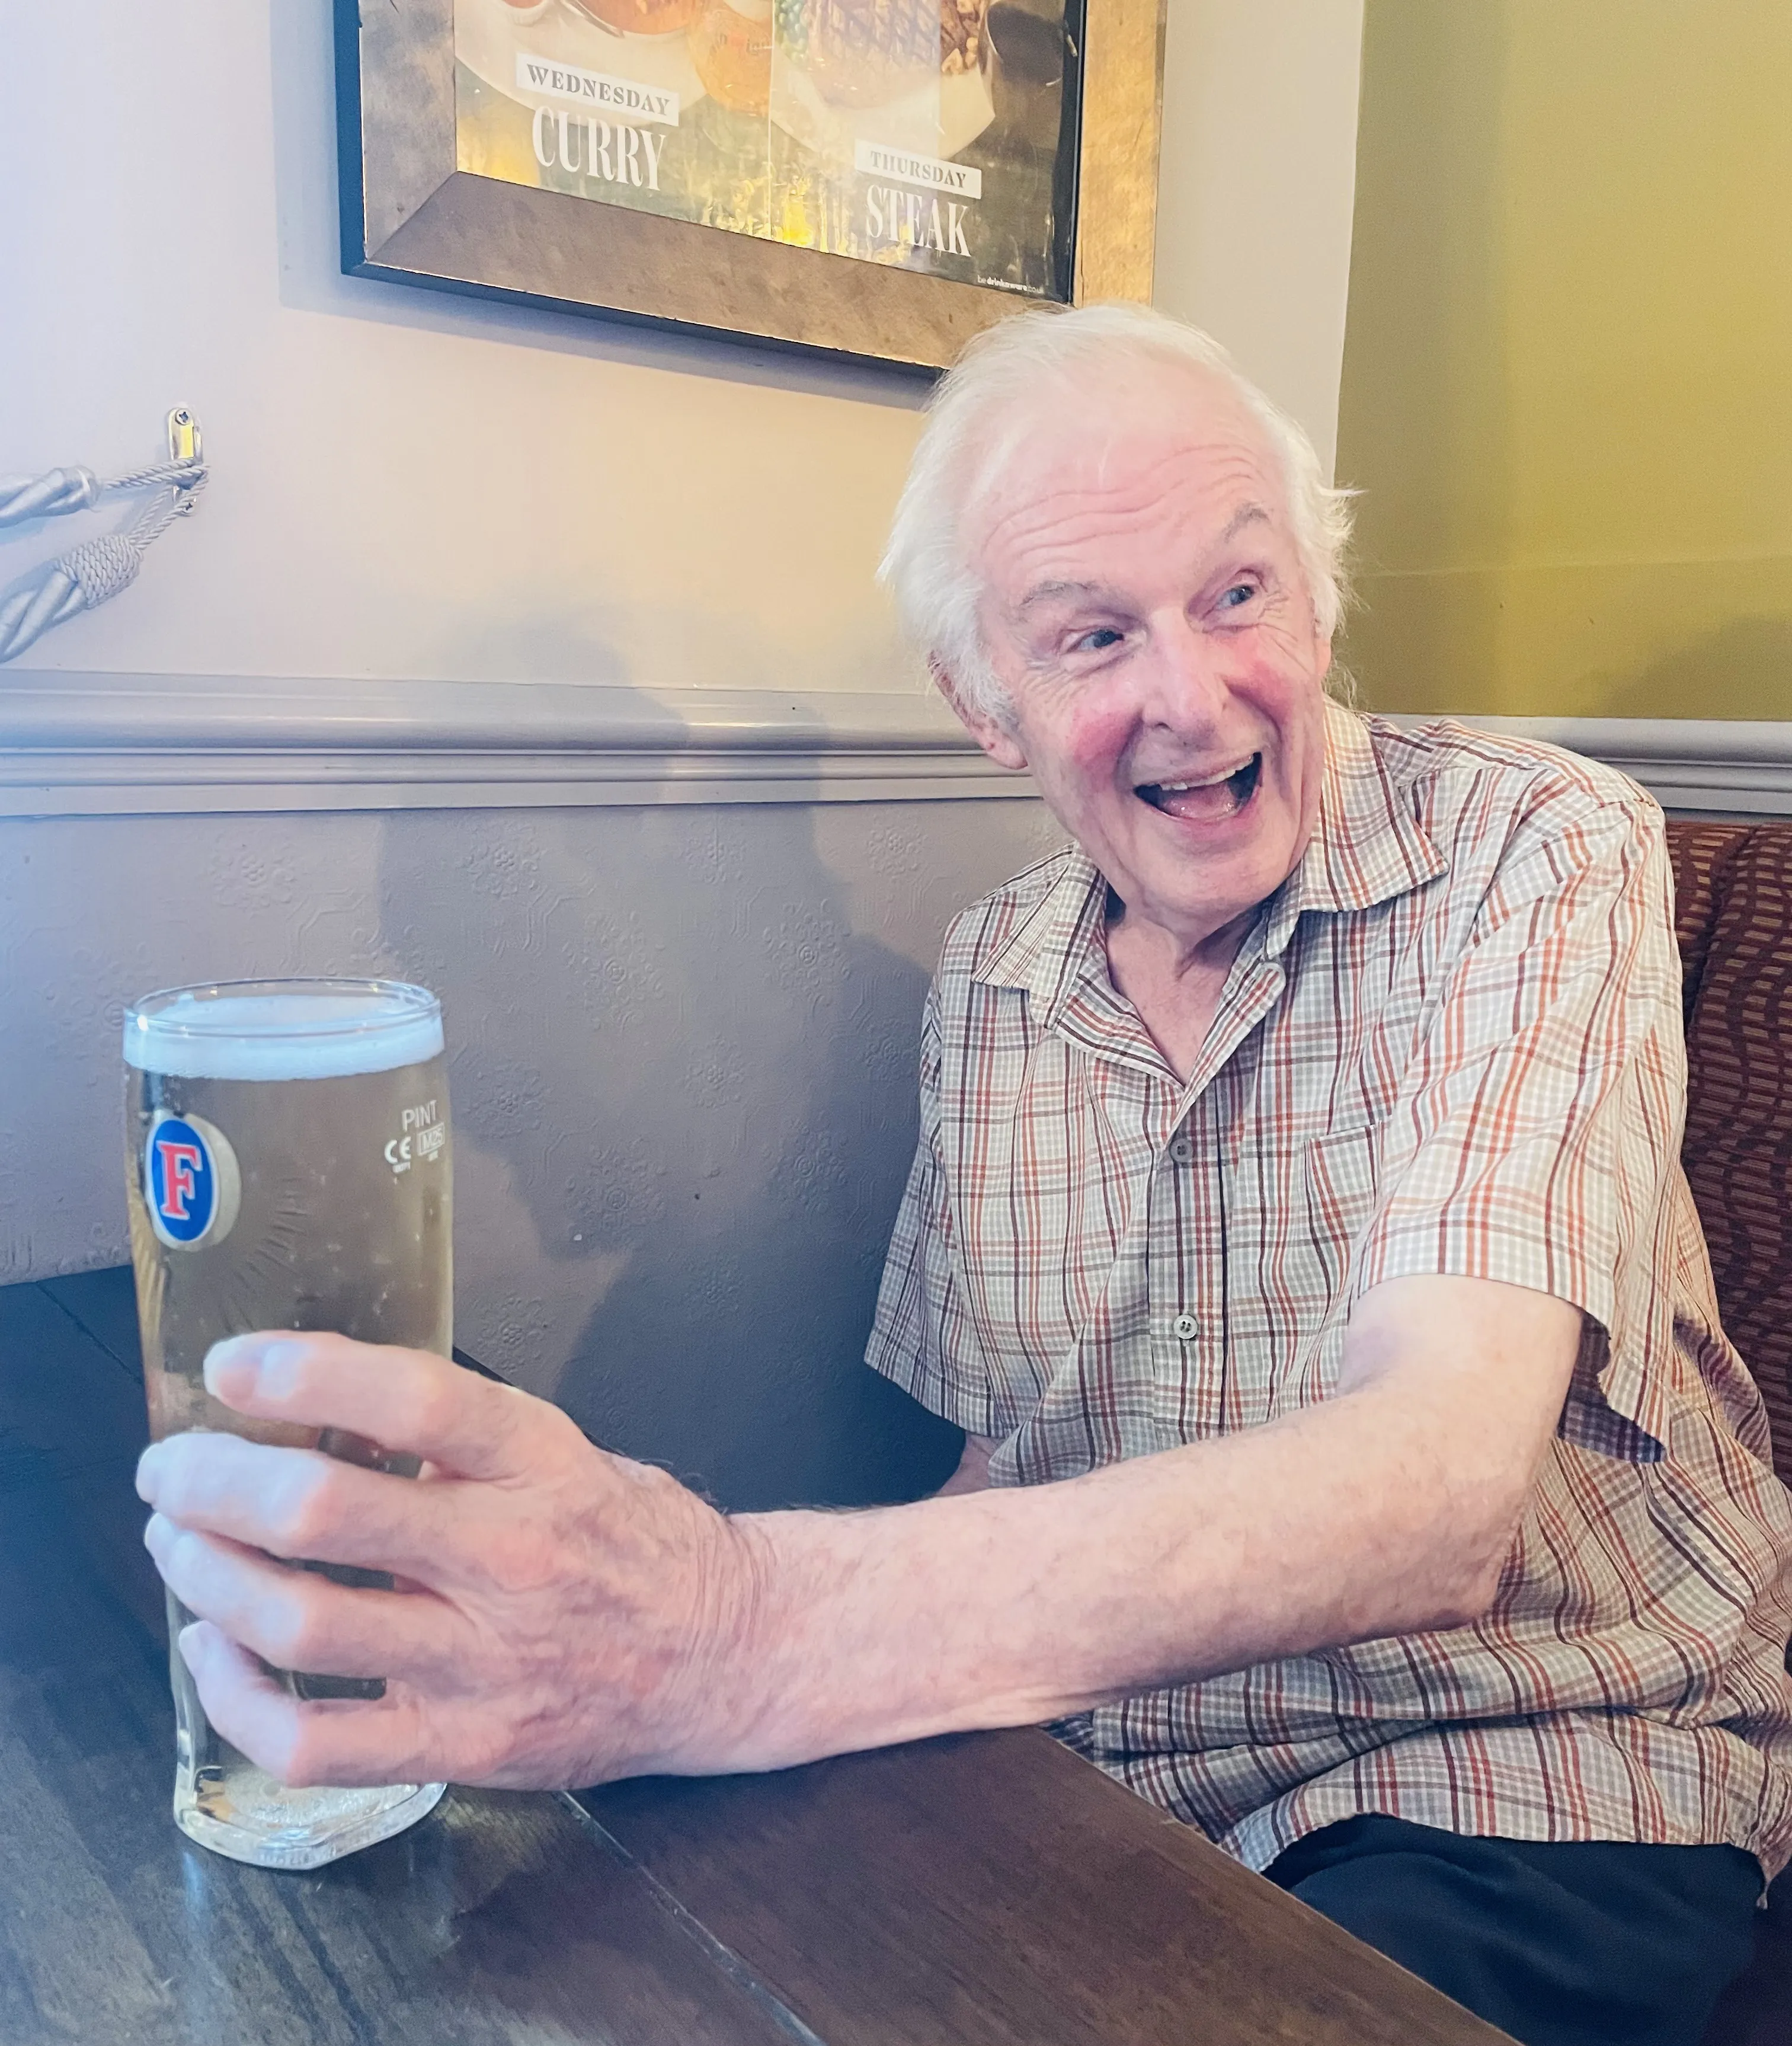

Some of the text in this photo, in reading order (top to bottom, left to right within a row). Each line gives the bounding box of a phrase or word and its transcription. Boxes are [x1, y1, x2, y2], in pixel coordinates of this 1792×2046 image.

[527, 64, 670, 116] WEDNESDAY
[532, 106, 667, 191] CURRY
[871, 151, 967, 188] THURSDAY
[866, 184, 971, 257] STEAK
[401, 1099, 437, 1131] PINT
[156, 1140, 203, 1220] F
